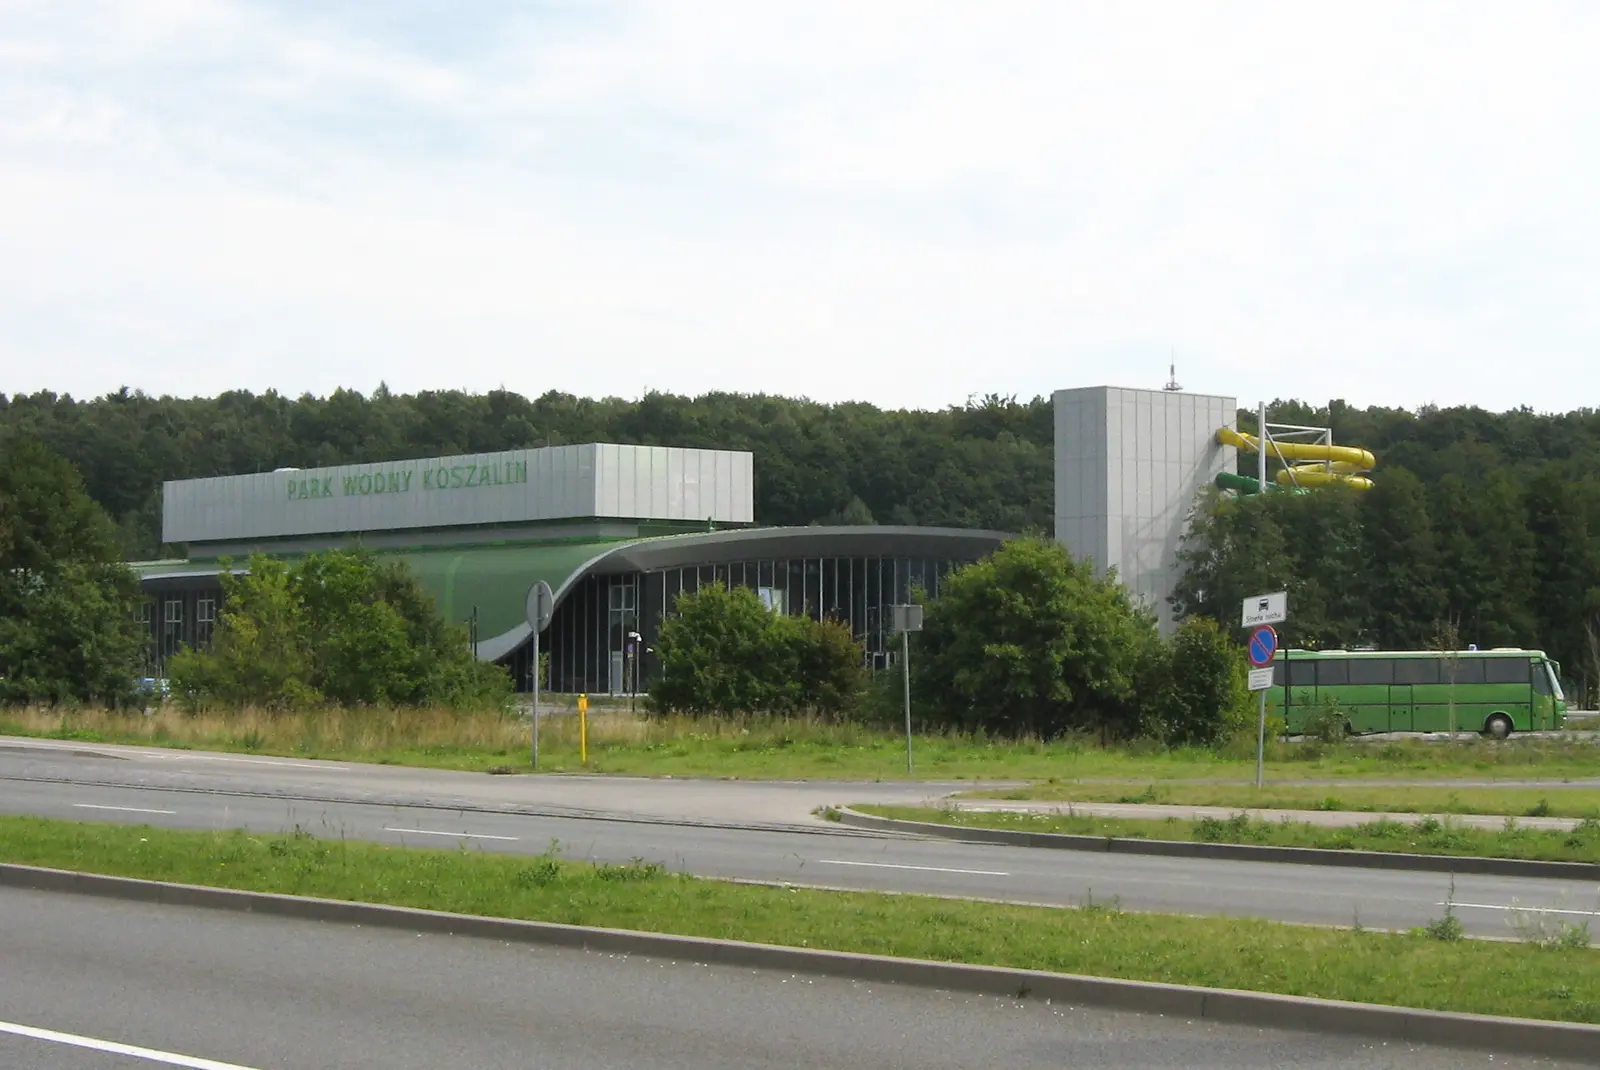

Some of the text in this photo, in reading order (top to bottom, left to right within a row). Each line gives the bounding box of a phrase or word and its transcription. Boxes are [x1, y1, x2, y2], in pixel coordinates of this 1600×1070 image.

[287, 461, 527, 500] PARK WODNY KOSZALIN
